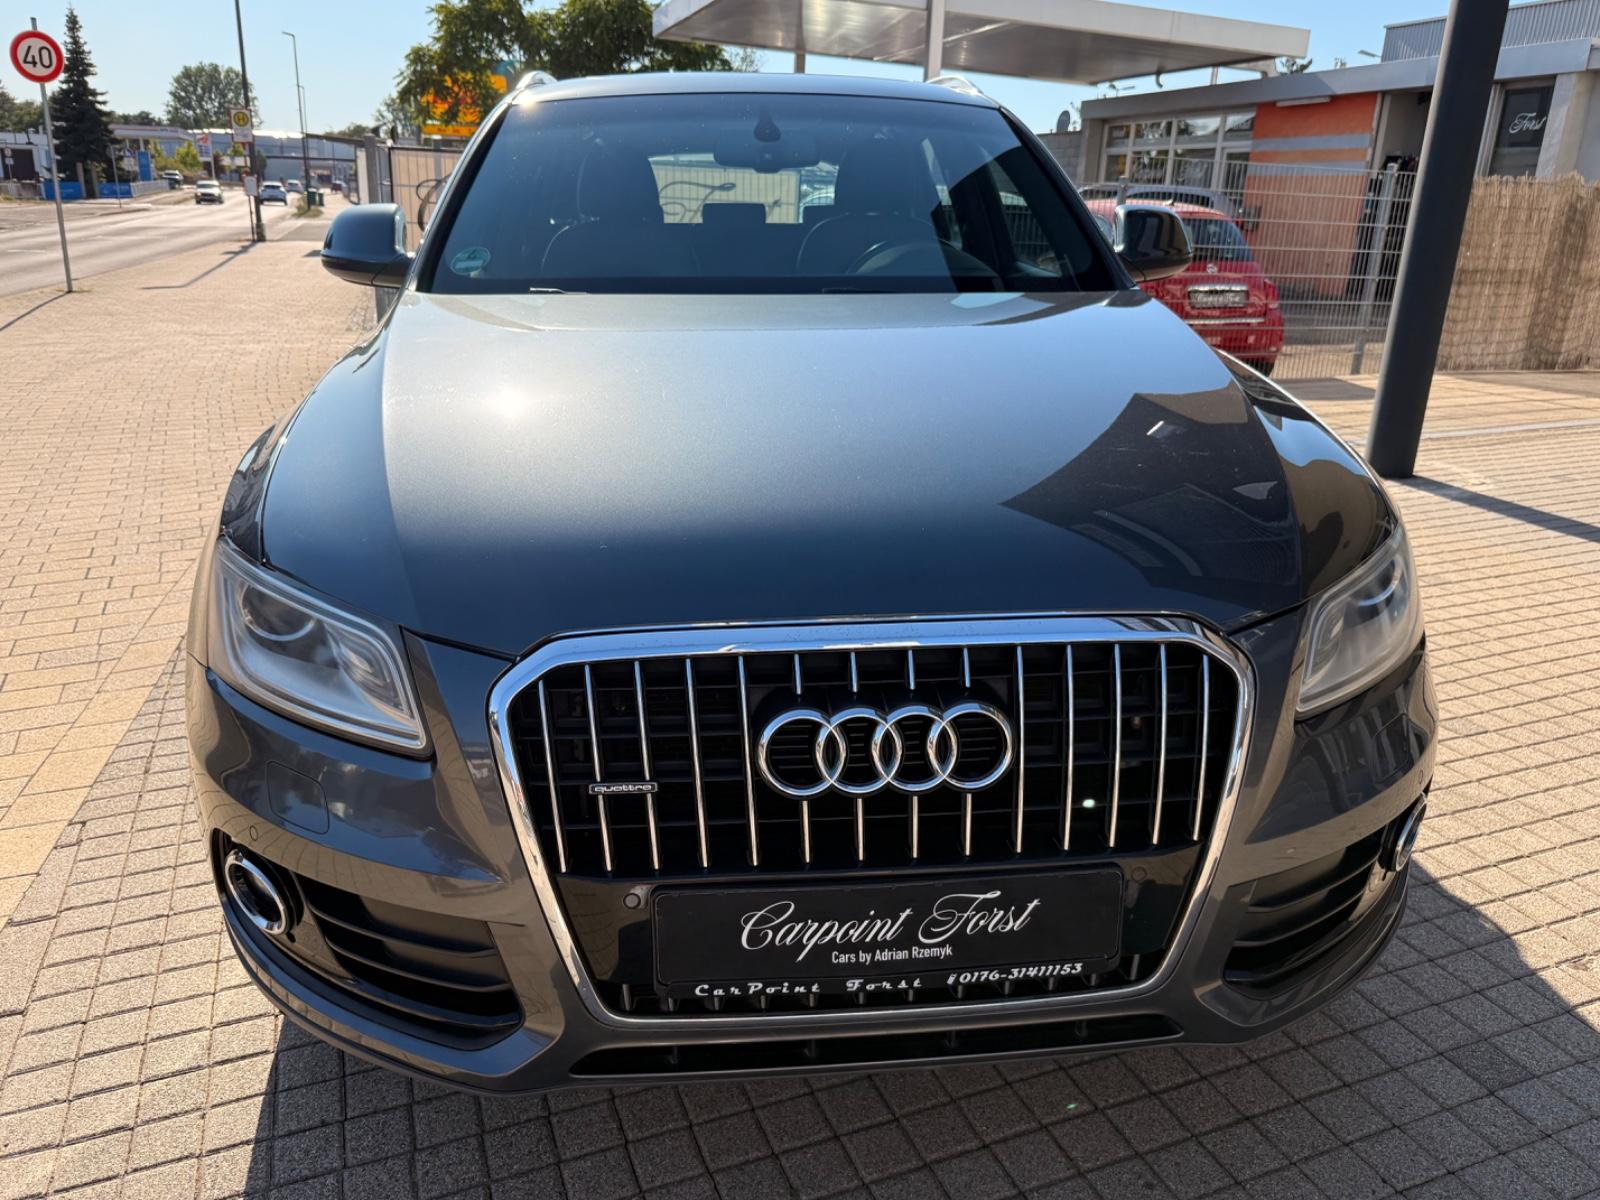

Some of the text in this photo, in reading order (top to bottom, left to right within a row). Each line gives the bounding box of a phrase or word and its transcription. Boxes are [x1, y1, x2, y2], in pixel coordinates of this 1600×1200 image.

[23, 45, 53, 69] 40
[594, 784, 652, 794] quattro
[741, 890, 1041, 963] Carpoint Forst
[831, 944, 953, 965] Cars by Adrian Rzemyk
[846, 977, 922, 992] Forst
